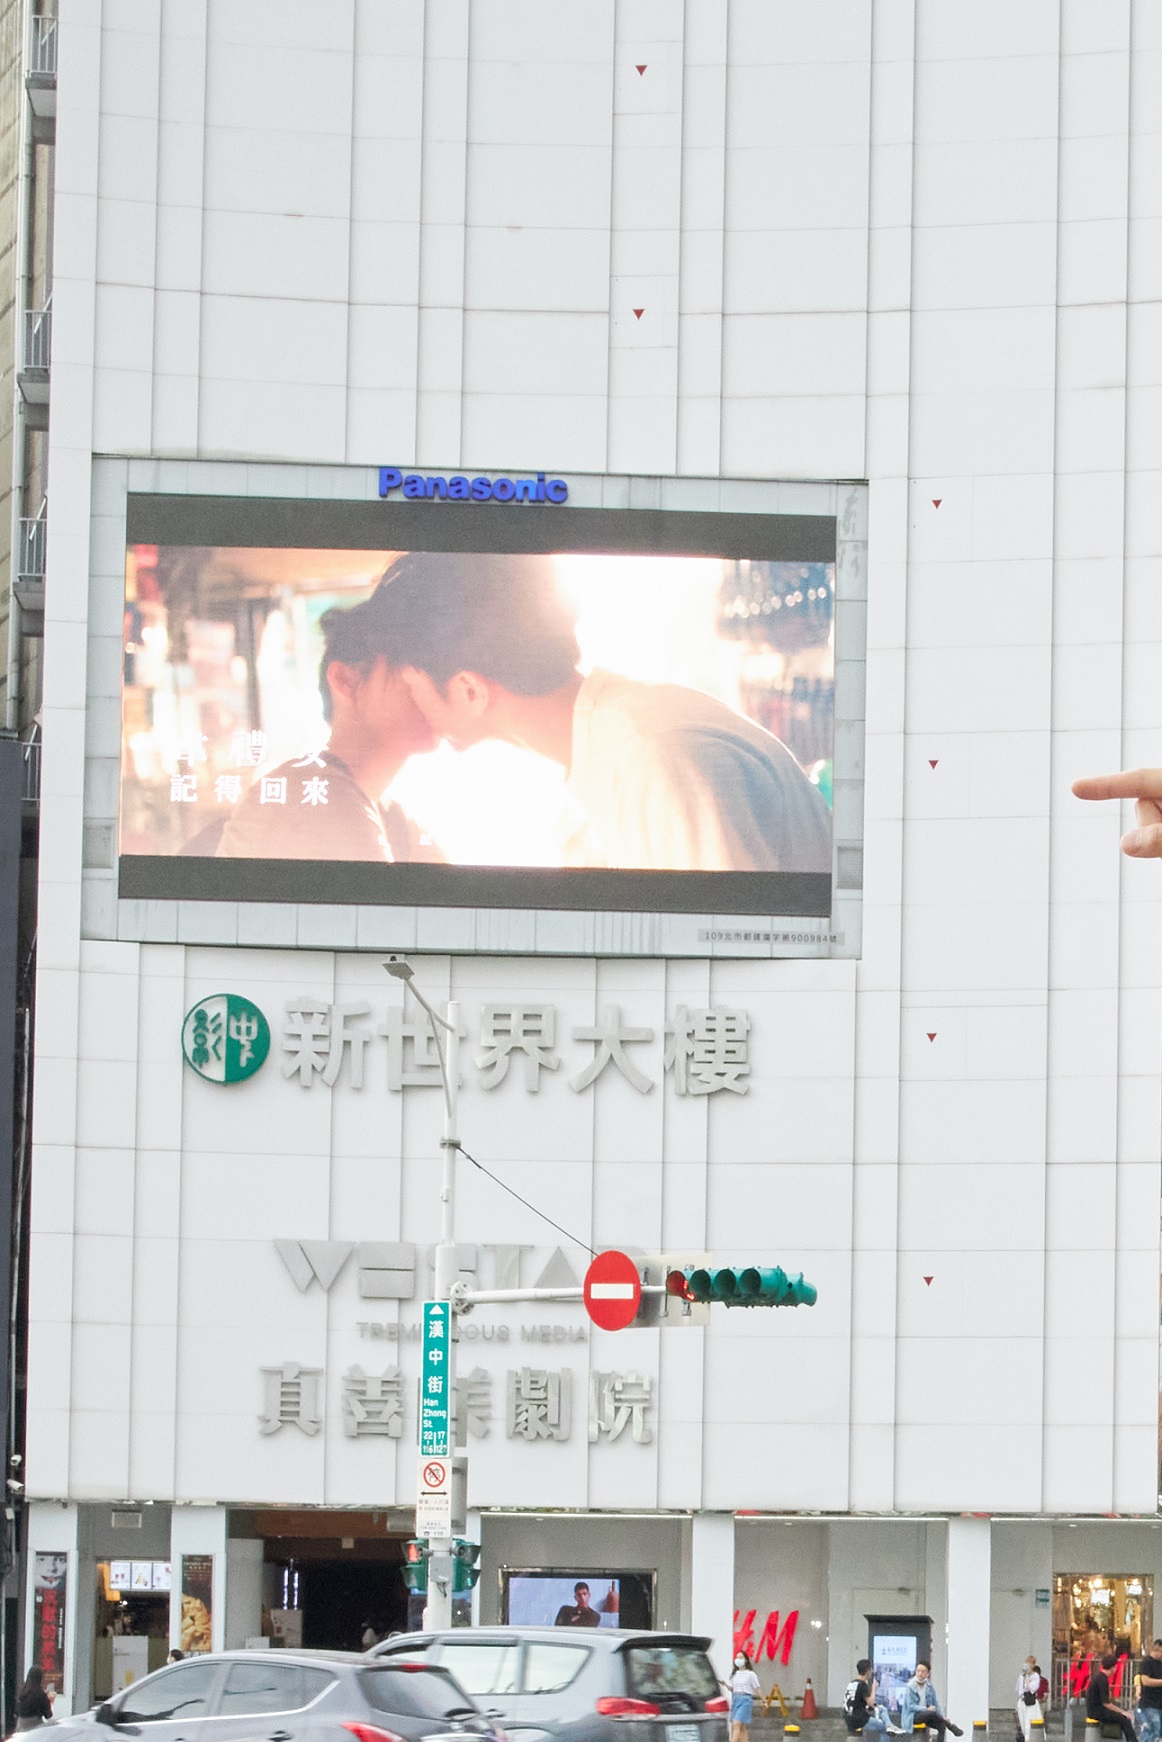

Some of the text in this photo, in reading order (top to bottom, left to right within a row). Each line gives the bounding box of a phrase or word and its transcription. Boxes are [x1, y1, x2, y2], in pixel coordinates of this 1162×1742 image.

[378, 466, 569, 504] Panasonic
[170, 774, 329, 806] 記得回來
[282, 996, 752, 1097] 新世界大樓
[428, 1320, 444, 1394] 漢中街
[423, 1398, 439, 1406] Han
[423, 1408, 447, 1419] Zhong
